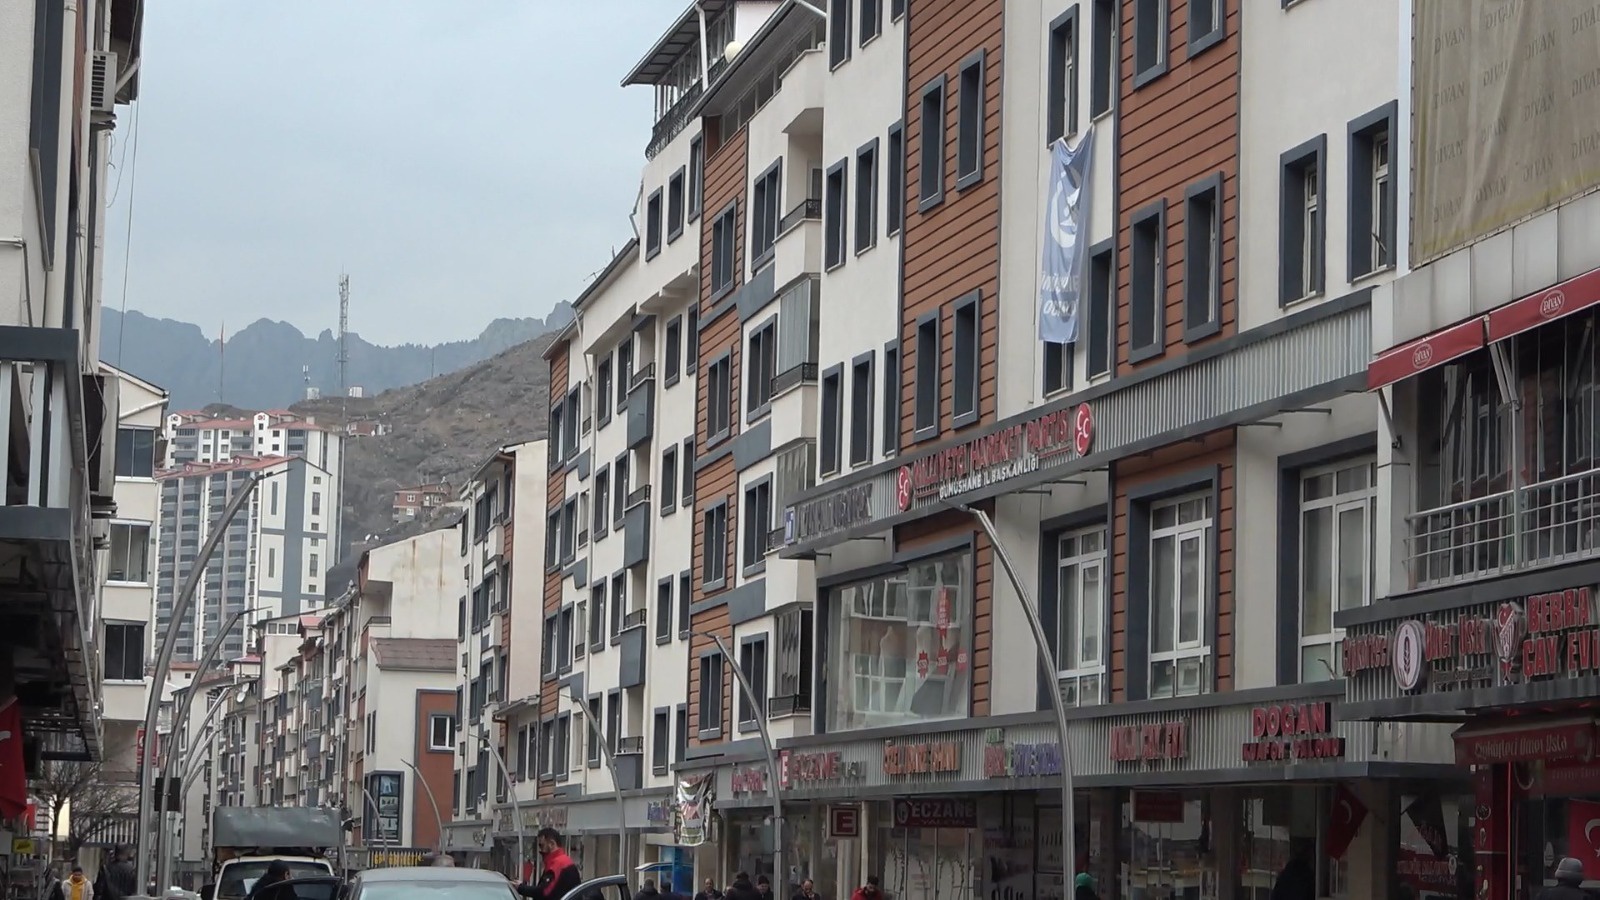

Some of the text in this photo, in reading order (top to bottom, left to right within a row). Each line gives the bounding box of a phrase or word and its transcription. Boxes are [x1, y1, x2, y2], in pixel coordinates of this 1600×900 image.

[1434, 26, 1466, 55] DIVAN
[992, 454, 1039, 482] BAŞKANLIĞI
[912, 801, 973, 818] ECZANE
